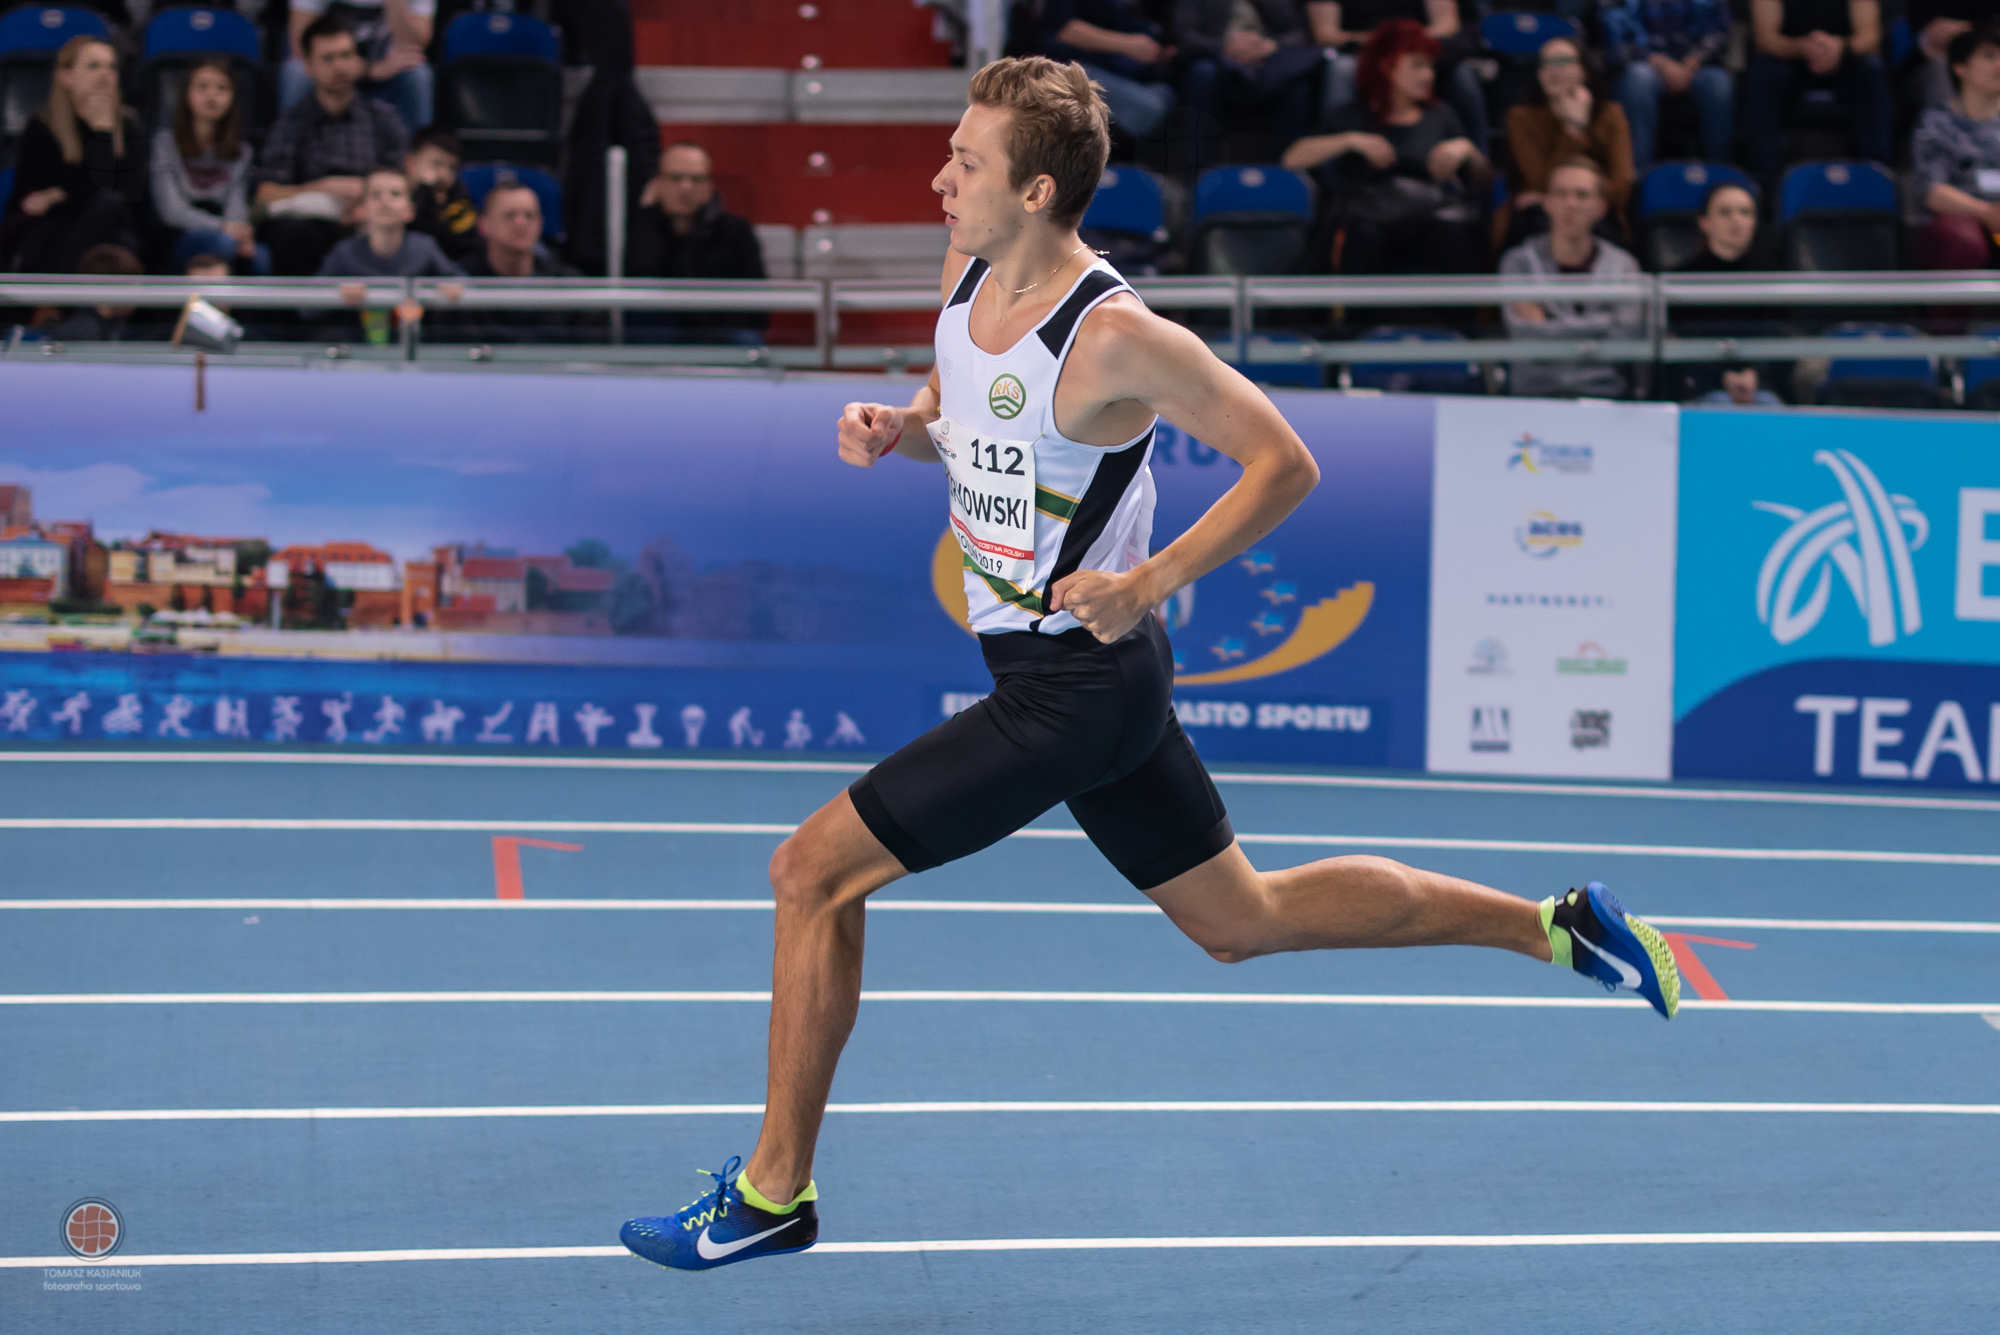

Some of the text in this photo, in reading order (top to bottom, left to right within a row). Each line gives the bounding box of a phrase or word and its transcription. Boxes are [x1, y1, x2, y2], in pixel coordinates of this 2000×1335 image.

[993, 380, 1021, 400] RKS
[970, 438, 1026, 476] 112
[978, 552, 1003, 574] 2019
[1170, 700, 1372, 733] ASTO SPORTU
